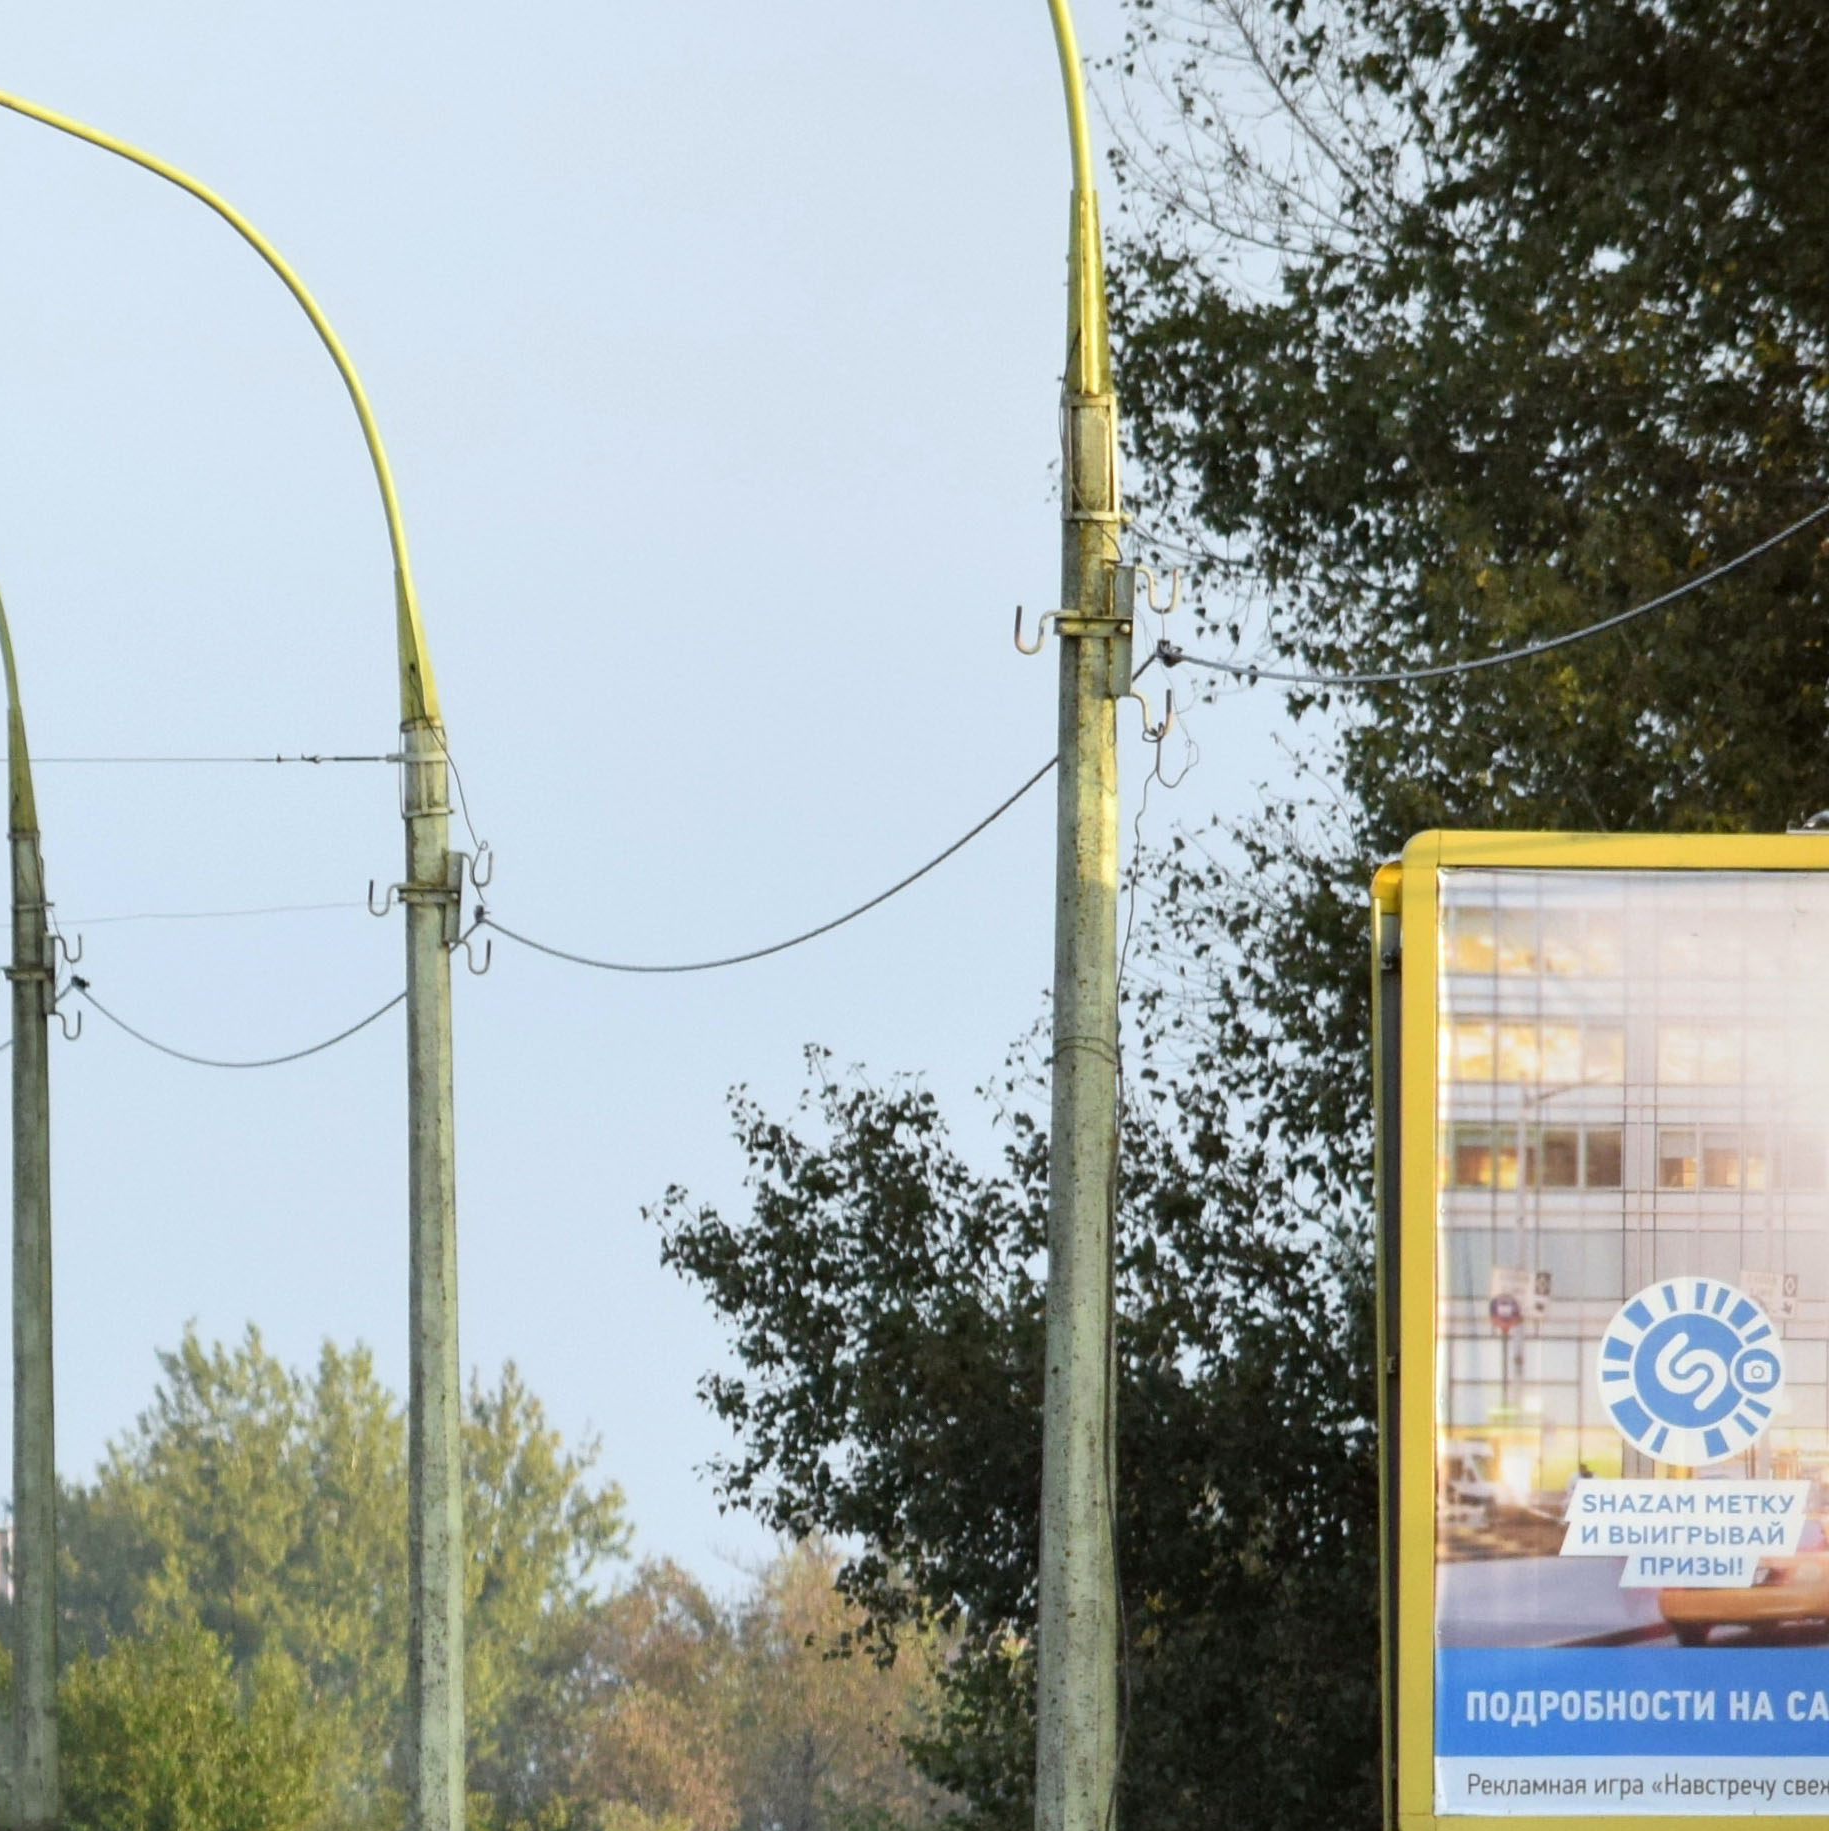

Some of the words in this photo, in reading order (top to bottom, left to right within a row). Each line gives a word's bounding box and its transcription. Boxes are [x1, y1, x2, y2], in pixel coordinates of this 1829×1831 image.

[1581, 1494, 1696, 1514] SHAZAM
[1705, 1494, 1795, 1514] МЕТКУ
[1581, 1526, 1599, 1545] И
[1608, 1521, 1785, 1545] ВЫИГРЫВАЙ
[1640, 1556, 1743, 1577] ПРИЗЫ!
[1467, 1690, 1716, 1728] ПОДРОБНОСТИ
[1729, 1690, 1774, 1721] НА
[1468, 1773, 1587, 1796] Рекламная
[1594, 1778, 1643, 1800] игра
[1651, 1772, 1777, 1801] «Навстречу
